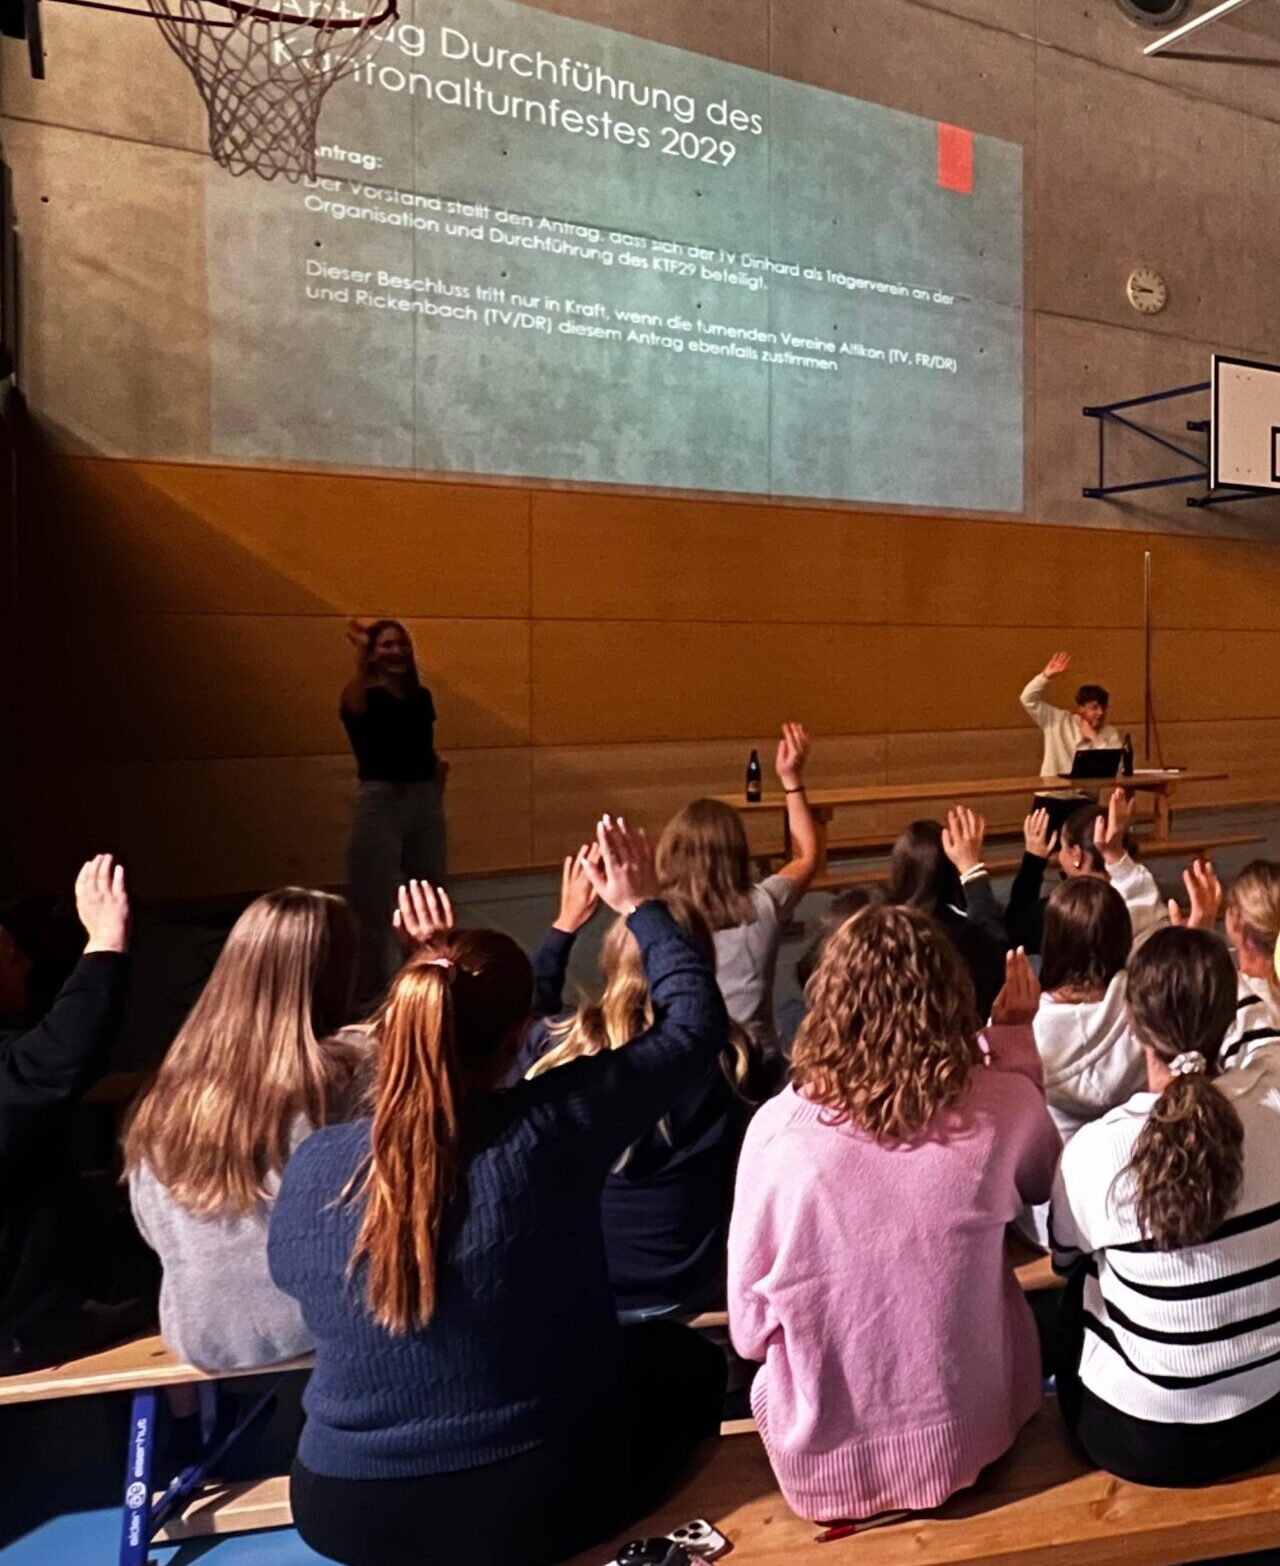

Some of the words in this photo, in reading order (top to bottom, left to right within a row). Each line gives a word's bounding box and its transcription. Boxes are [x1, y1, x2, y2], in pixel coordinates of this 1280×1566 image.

[441, 27, 695, 123] Durchführung
[706, 100, 763, 135] des
[314, 145, 384, 170] ntrag:
[661, 127, 737, 168] 2029
[304, 195, 440, 233] Organisation
[445, 221, 485, 241] und
[489, 227, 614, 266] Durchführung
[618, 251, 649, 270] des
[652, 256, 697, 277] KTF29
[447, 200, 490, 219] stellt
[495, 207, 533, 228] den
[741, 253, 800, 277] Dinhard
[803, 267, 823, 282] als
[912, 288, 931, 302] an
[932, 289, 955, 306] der
[305, 285, 350, 304] und
[355, 289, 478, 321] Rickenbach
[484, 307, 552, 335] (TV/DR)
[558, 319, 622, 342] diesem
[626, 329, 684, 353] Antrag
[687, 338, 758, 361] ebenfalls
[760, 350, 838, 371] zustimmen
[306, 259, 373, 284] Dieser
[377, 270, 470, 299] Beschluss
[476, 284, 505, 304] tritt
[510, 293, 541, 310] nur
[544, 295, 561, 313] in
[614, 309, 663, 328] wenn
[666, 315, 693, 332] die
[696, 319, 777, 345] turnenden
[780, 332, 837, 354] Vereine
